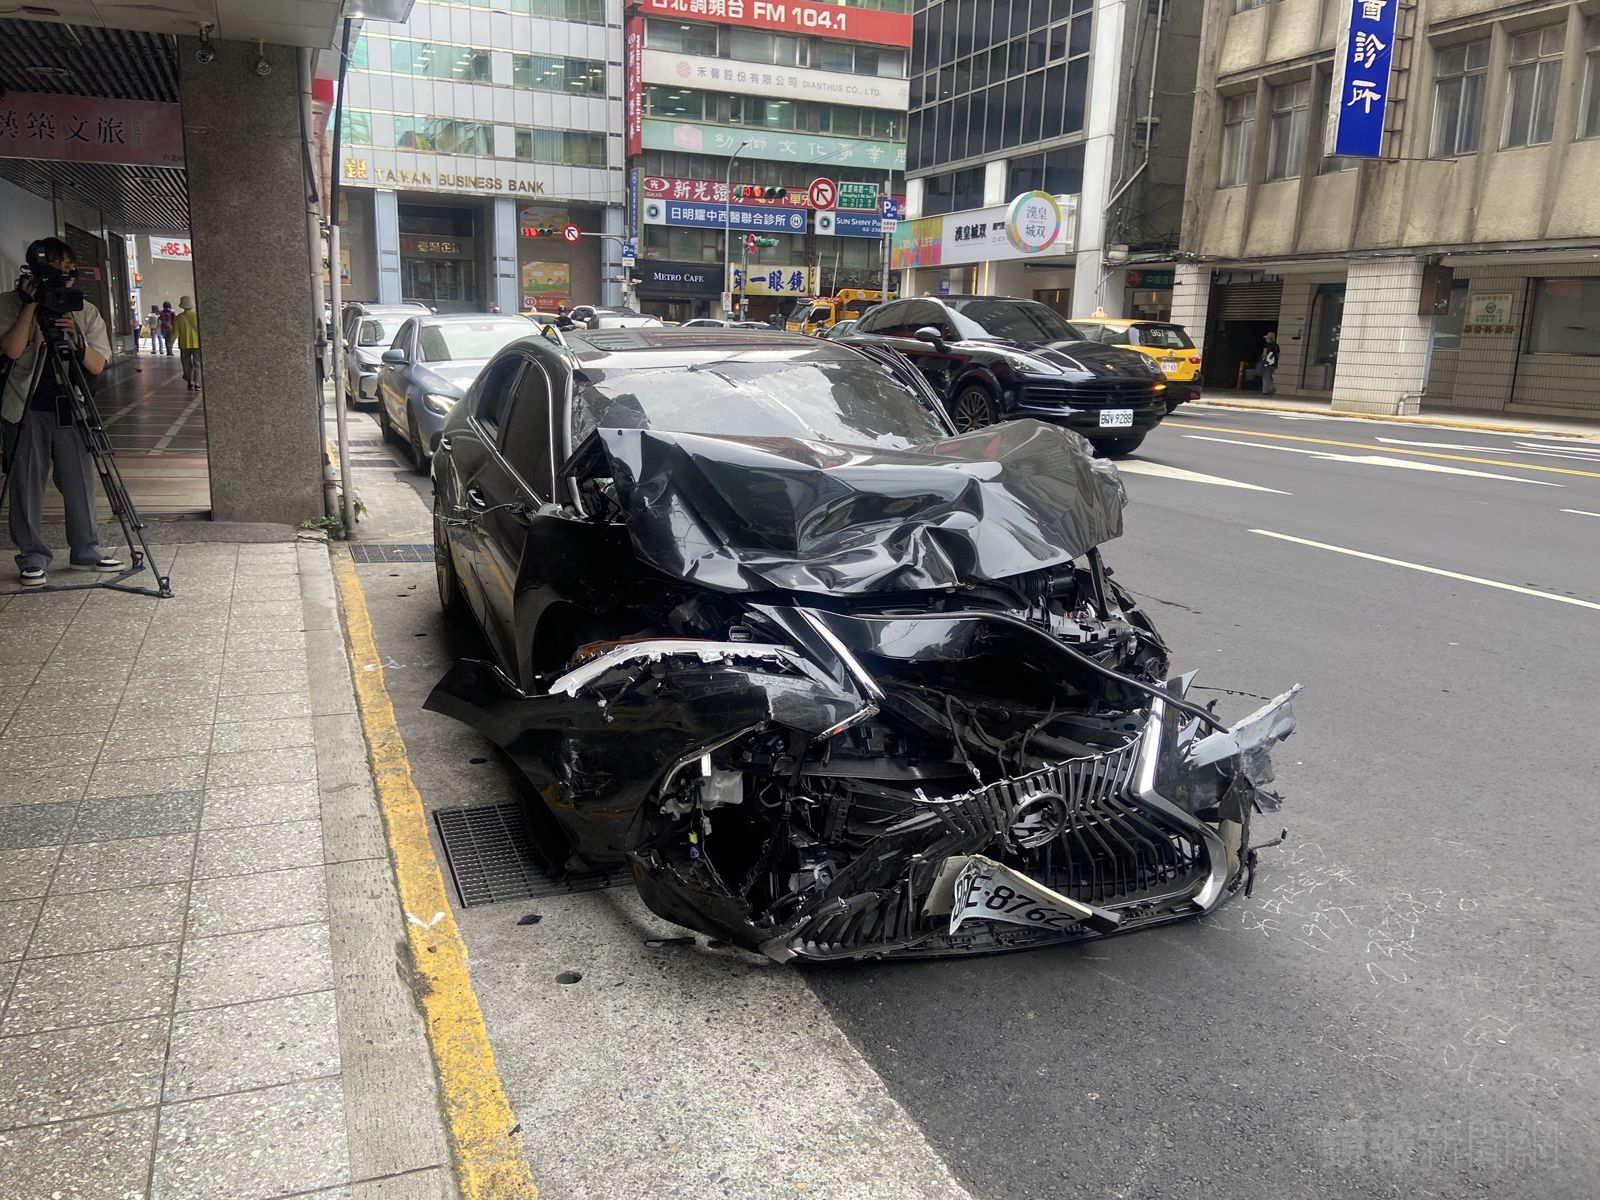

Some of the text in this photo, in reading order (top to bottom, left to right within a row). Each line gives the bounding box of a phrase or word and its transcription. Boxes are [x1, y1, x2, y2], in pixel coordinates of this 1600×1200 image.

[753, 2, 785, 22] FM
[792, 7, 847, 30] 104.1
[802, 80, 844, 93] DIANTHUS
[375, 167, 545, 194] TAIWAN BUSINESS BANK
[883, 200, 892, 214] P
[671, 206, 786, 230] 日明耀中西醫聯合診所
[836, 217, 851, 227] SUN
[851, 219, 871, 228] SHINY
[623, 245, 630, 257] P
[653, 271, 705, 284] METRO CAFE
[733, 268, 807, 294] 第一眼鏡
